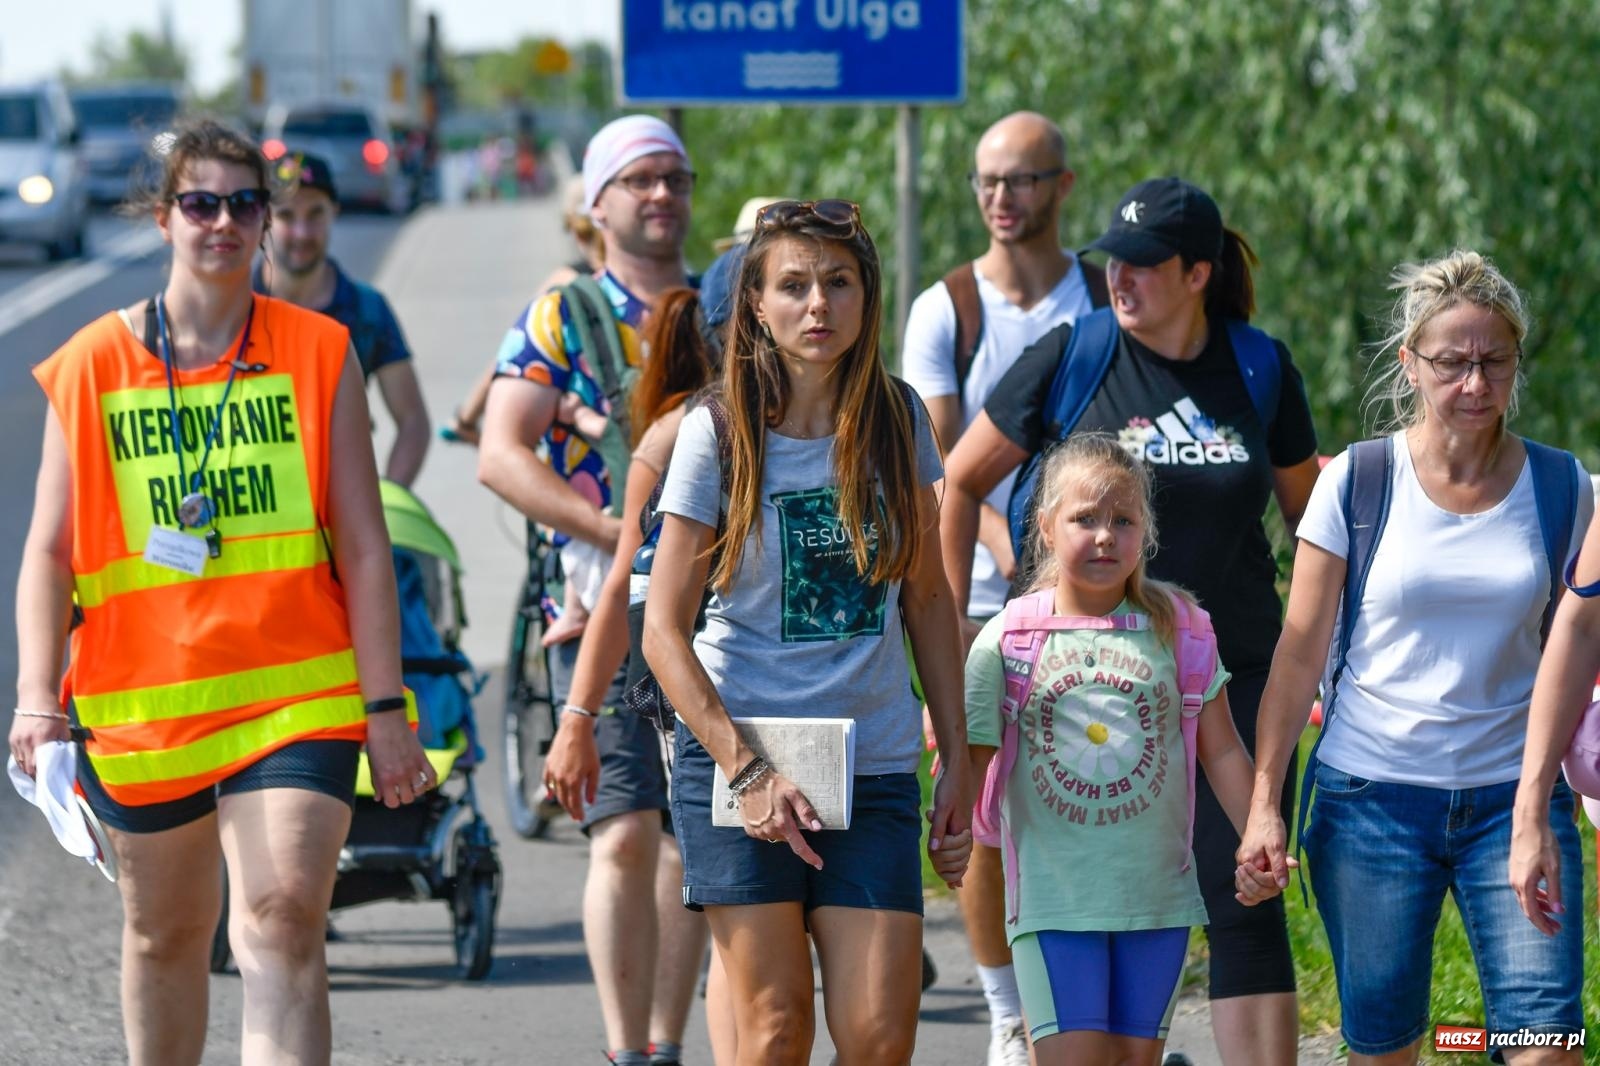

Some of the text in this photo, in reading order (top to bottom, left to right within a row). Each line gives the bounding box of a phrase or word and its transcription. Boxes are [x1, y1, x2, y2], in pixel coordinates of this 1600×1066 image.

[815, 0, 921, 40] Ulga
[109, 395, 296, 462] KIEROWANIE
[1119, 440, 1250, 465] adidas
[1099, 648, 1152, 681] FIND
[1025, 713, 1040, 761] YOU
[1040, 671, 1155, 799] AND YOU WILL BE HAPPY FOREVER!
[1147, 681, 1170, 798] SOMEONE
[1032, 765, 1088, 825] MAKES
[1094, 794, 1150, 826] THAT
